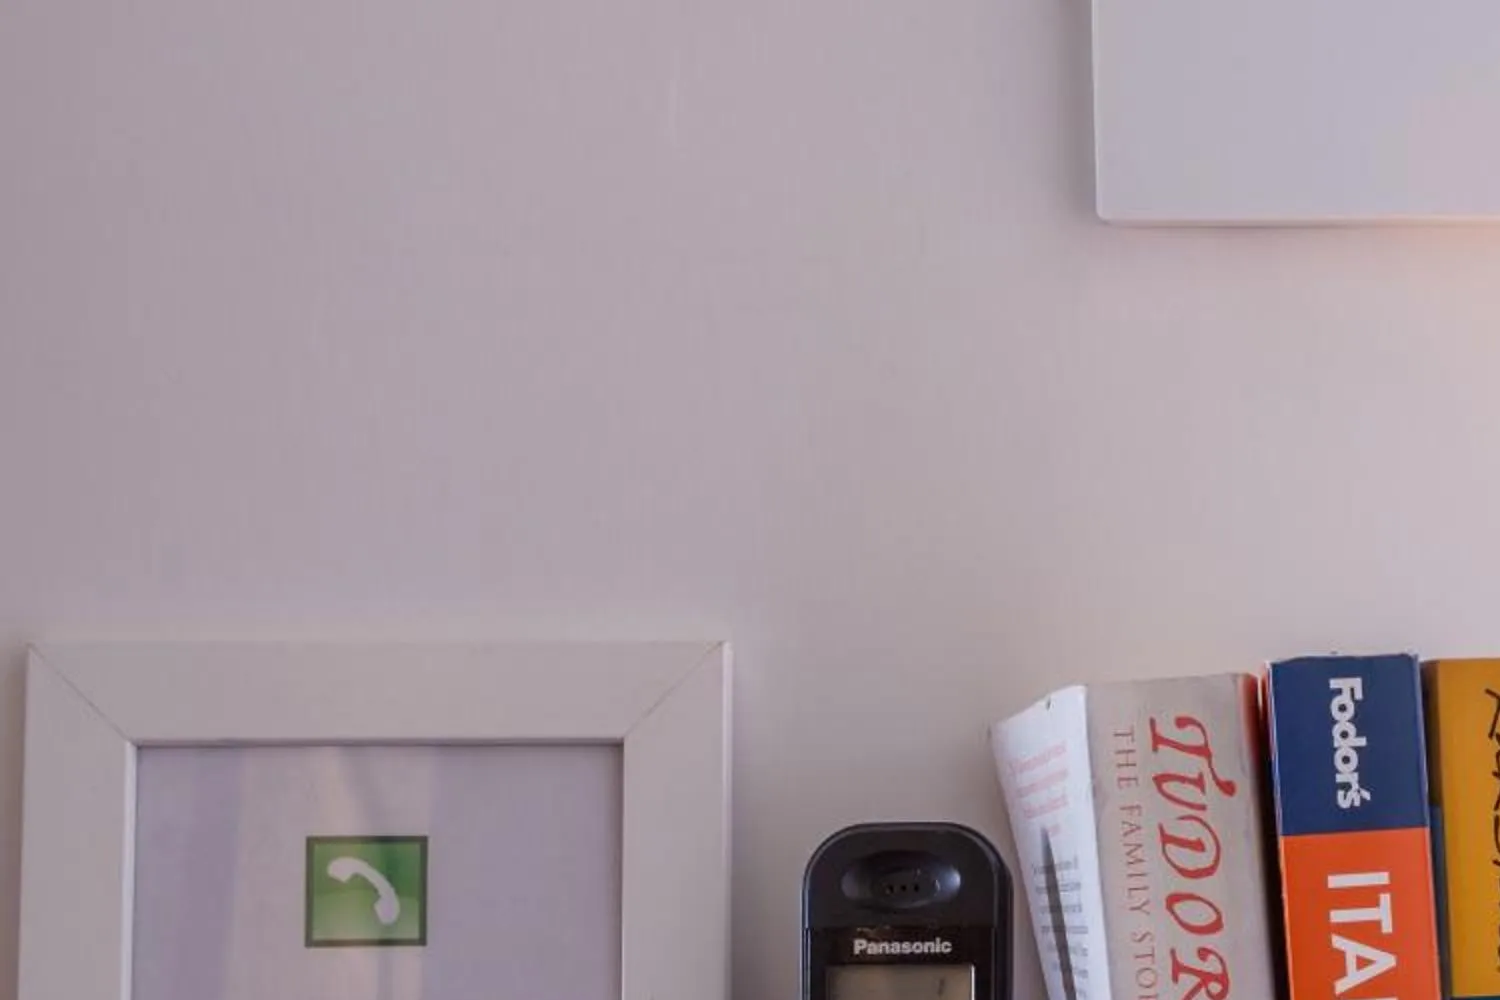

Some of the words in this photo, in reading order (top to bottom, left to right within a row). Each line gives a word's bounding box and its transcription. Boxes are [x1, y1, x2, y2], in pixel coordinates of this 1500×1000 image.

[1113, 729, 1139, 790] THE
[1328, 676, 1371, 809] Fodor's
[1120, 805, 1150, 915] FAMILY
[853, 937, 953, 955] Panasonic
